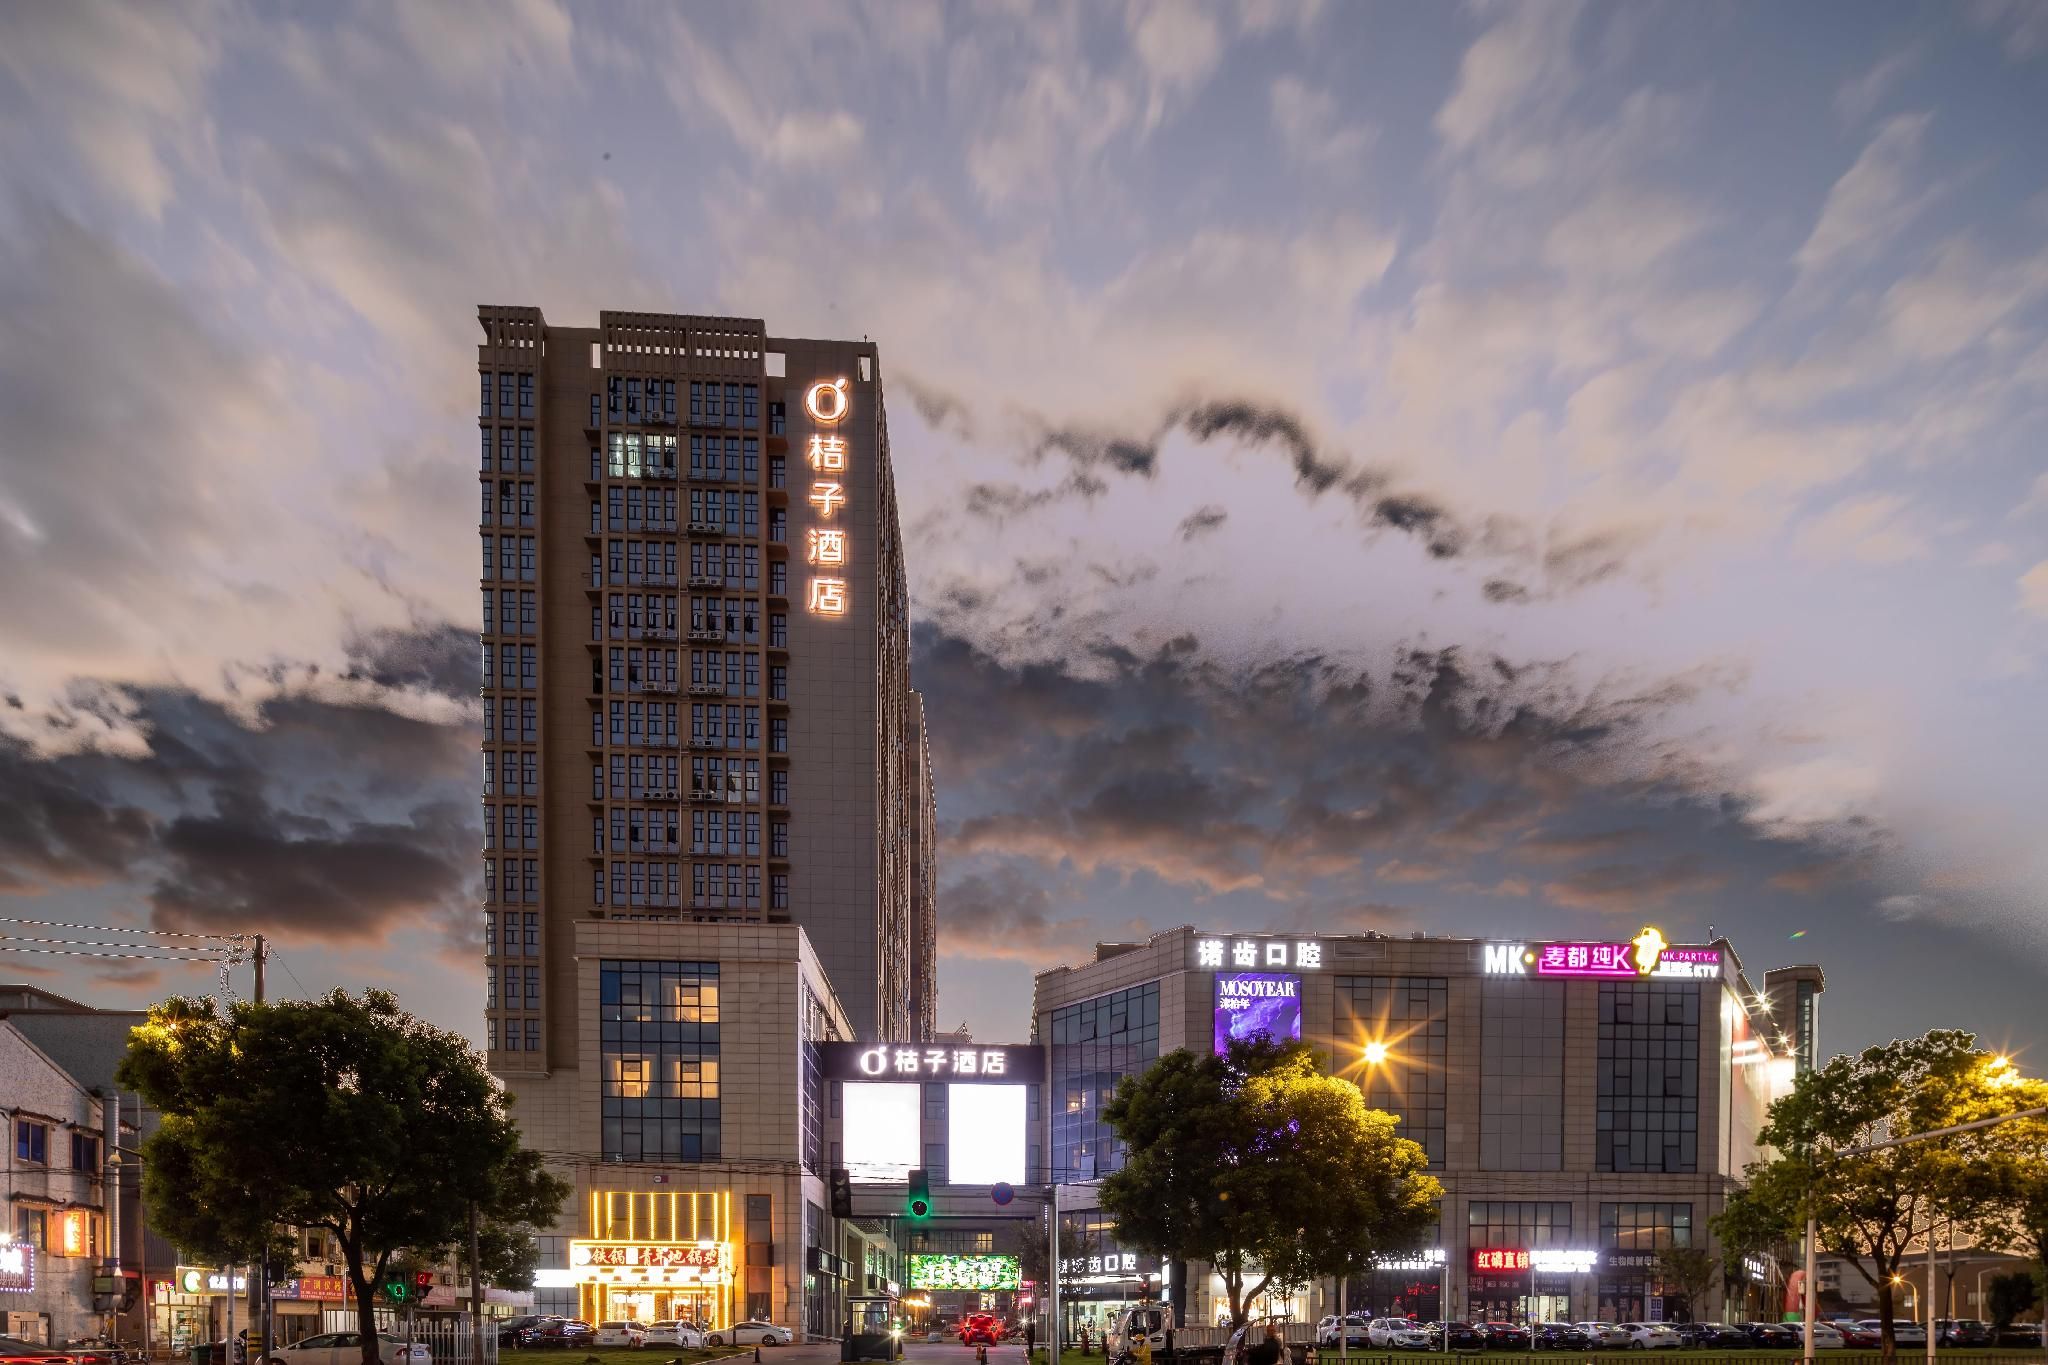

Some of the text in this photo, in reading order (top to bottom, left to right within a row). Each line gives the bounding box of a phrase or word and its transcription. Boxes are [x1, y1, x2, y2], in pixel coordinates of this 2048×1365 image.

[808, 434, 846, 616] 桔子酒店
[1219, 980, 1296, 997] MOSOYEAR
[894, 1049, 1006, 1074] 桔子酒店
